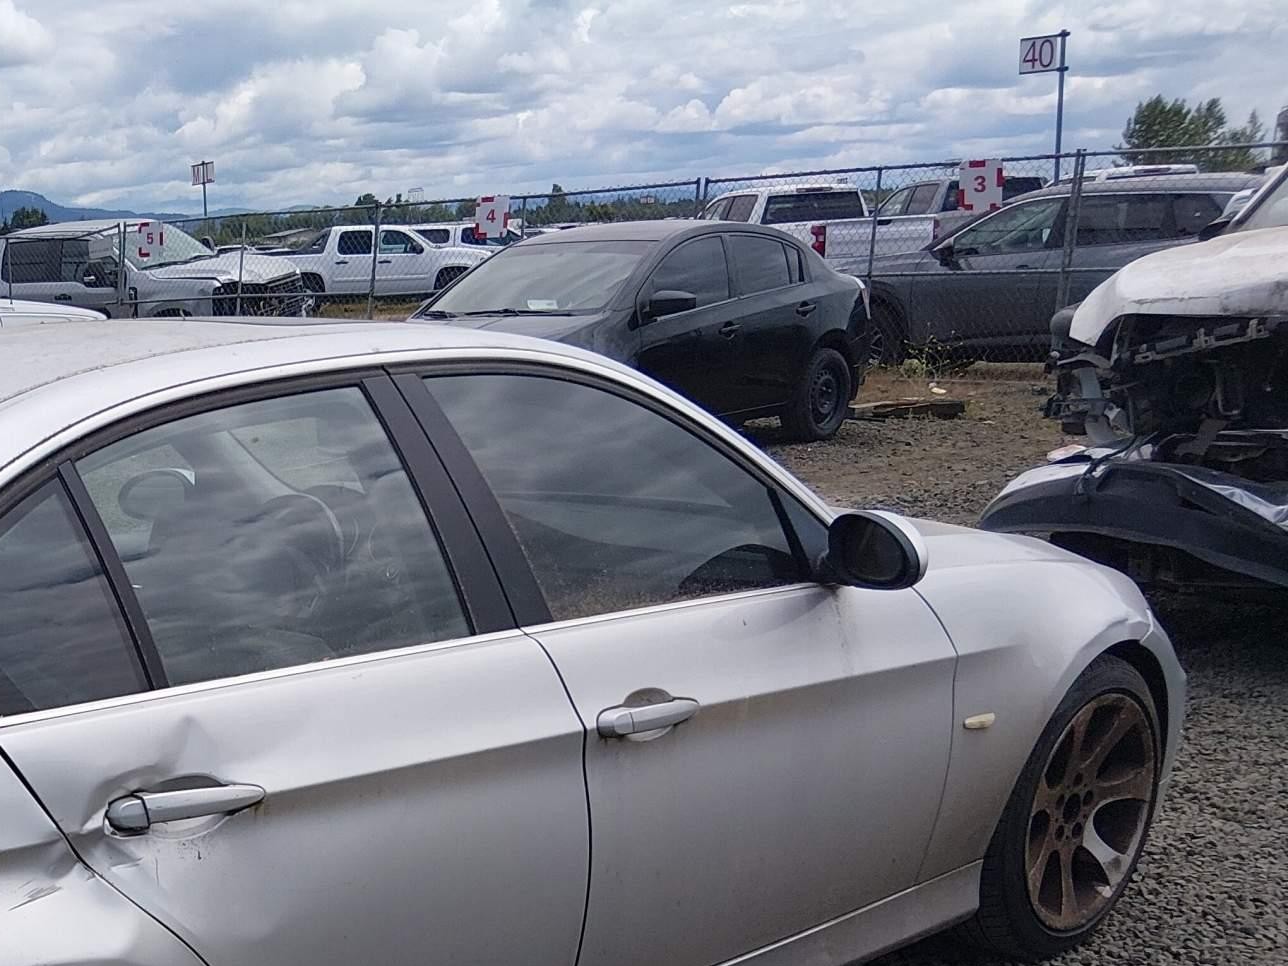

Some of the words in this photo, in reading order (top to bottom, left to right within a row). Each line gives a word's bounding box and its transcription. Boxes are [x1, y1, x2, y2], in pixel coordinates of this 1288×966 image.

[1022, 39, 1055, 70] 40
[973, 175, 987, 193] 3
[486, 208, 497, 223] 4
[146, 232, 154, 245] 5
